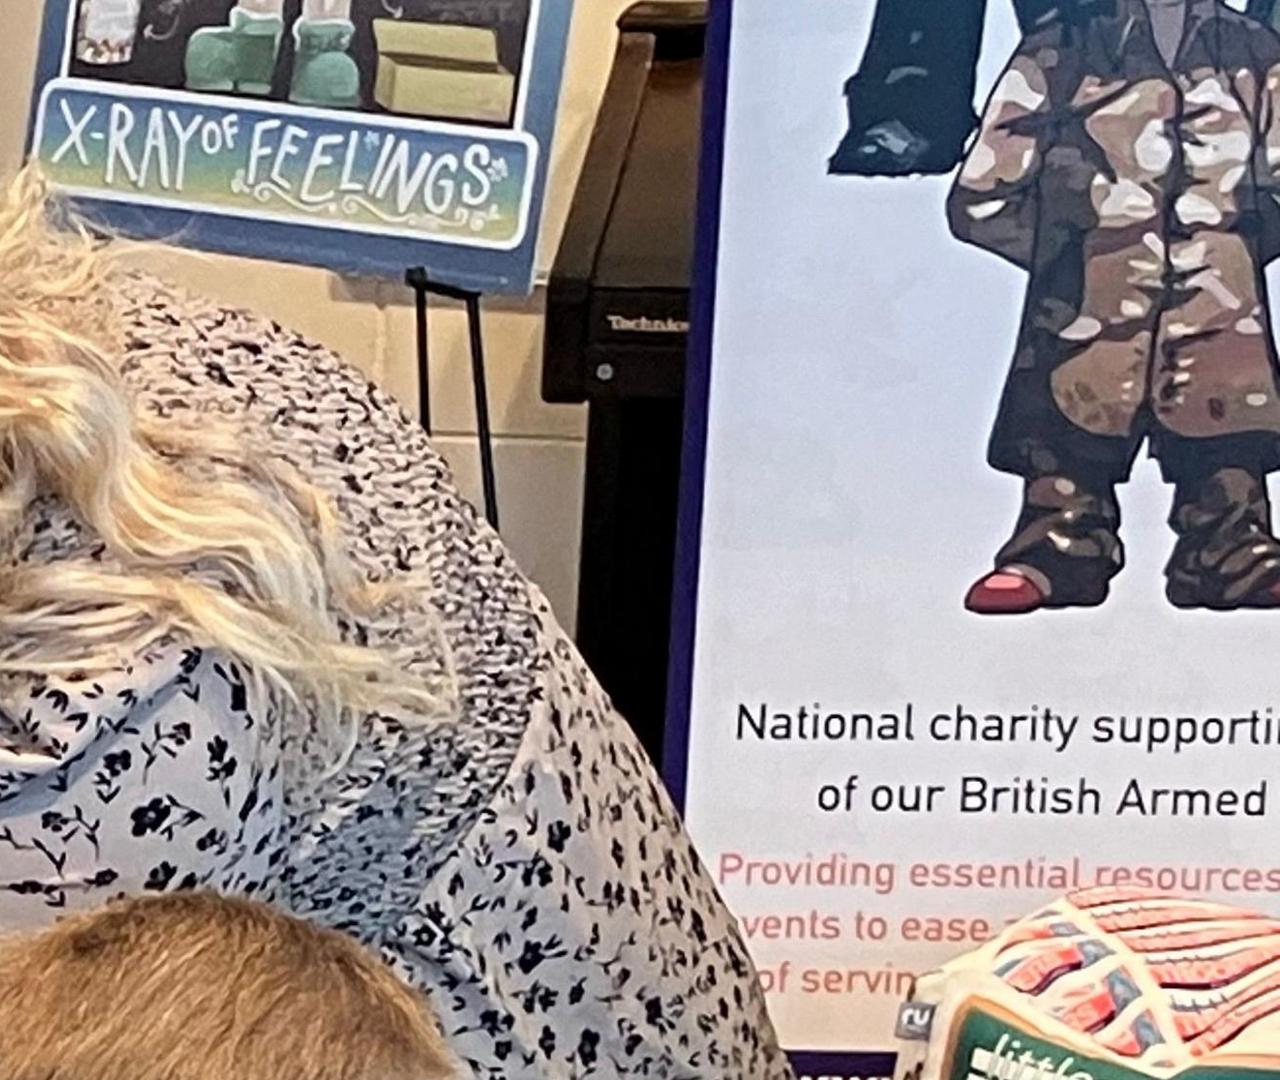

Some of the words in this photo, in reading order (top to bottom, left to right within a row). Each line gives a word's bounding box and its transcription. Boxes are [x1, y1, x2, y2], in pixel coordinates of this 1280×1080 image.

[52, 98, 205, 192] X-RAY
[201, 113, 240, 155] OF
[245, 118, 493, 215] FEELINGS
[736, 703, 915, 741] National
[930, 704, 1079, 752] charity
[817, 775, 859, 812] of
[871, 785, 946, 812] our
[959, 777, 1101, 815] British
[1116, 779, 1267, 816] Armed
[719, 853, 896, 895] Providing
[910, 857, 1081, 888] essential
[1096, 866, 1280, 892] resources
[742, 910, 840, 940] vents
[855, 911, 887, 941] to
[901, 917, 990, 943] ease
[802, 962, 917, 994] servin
